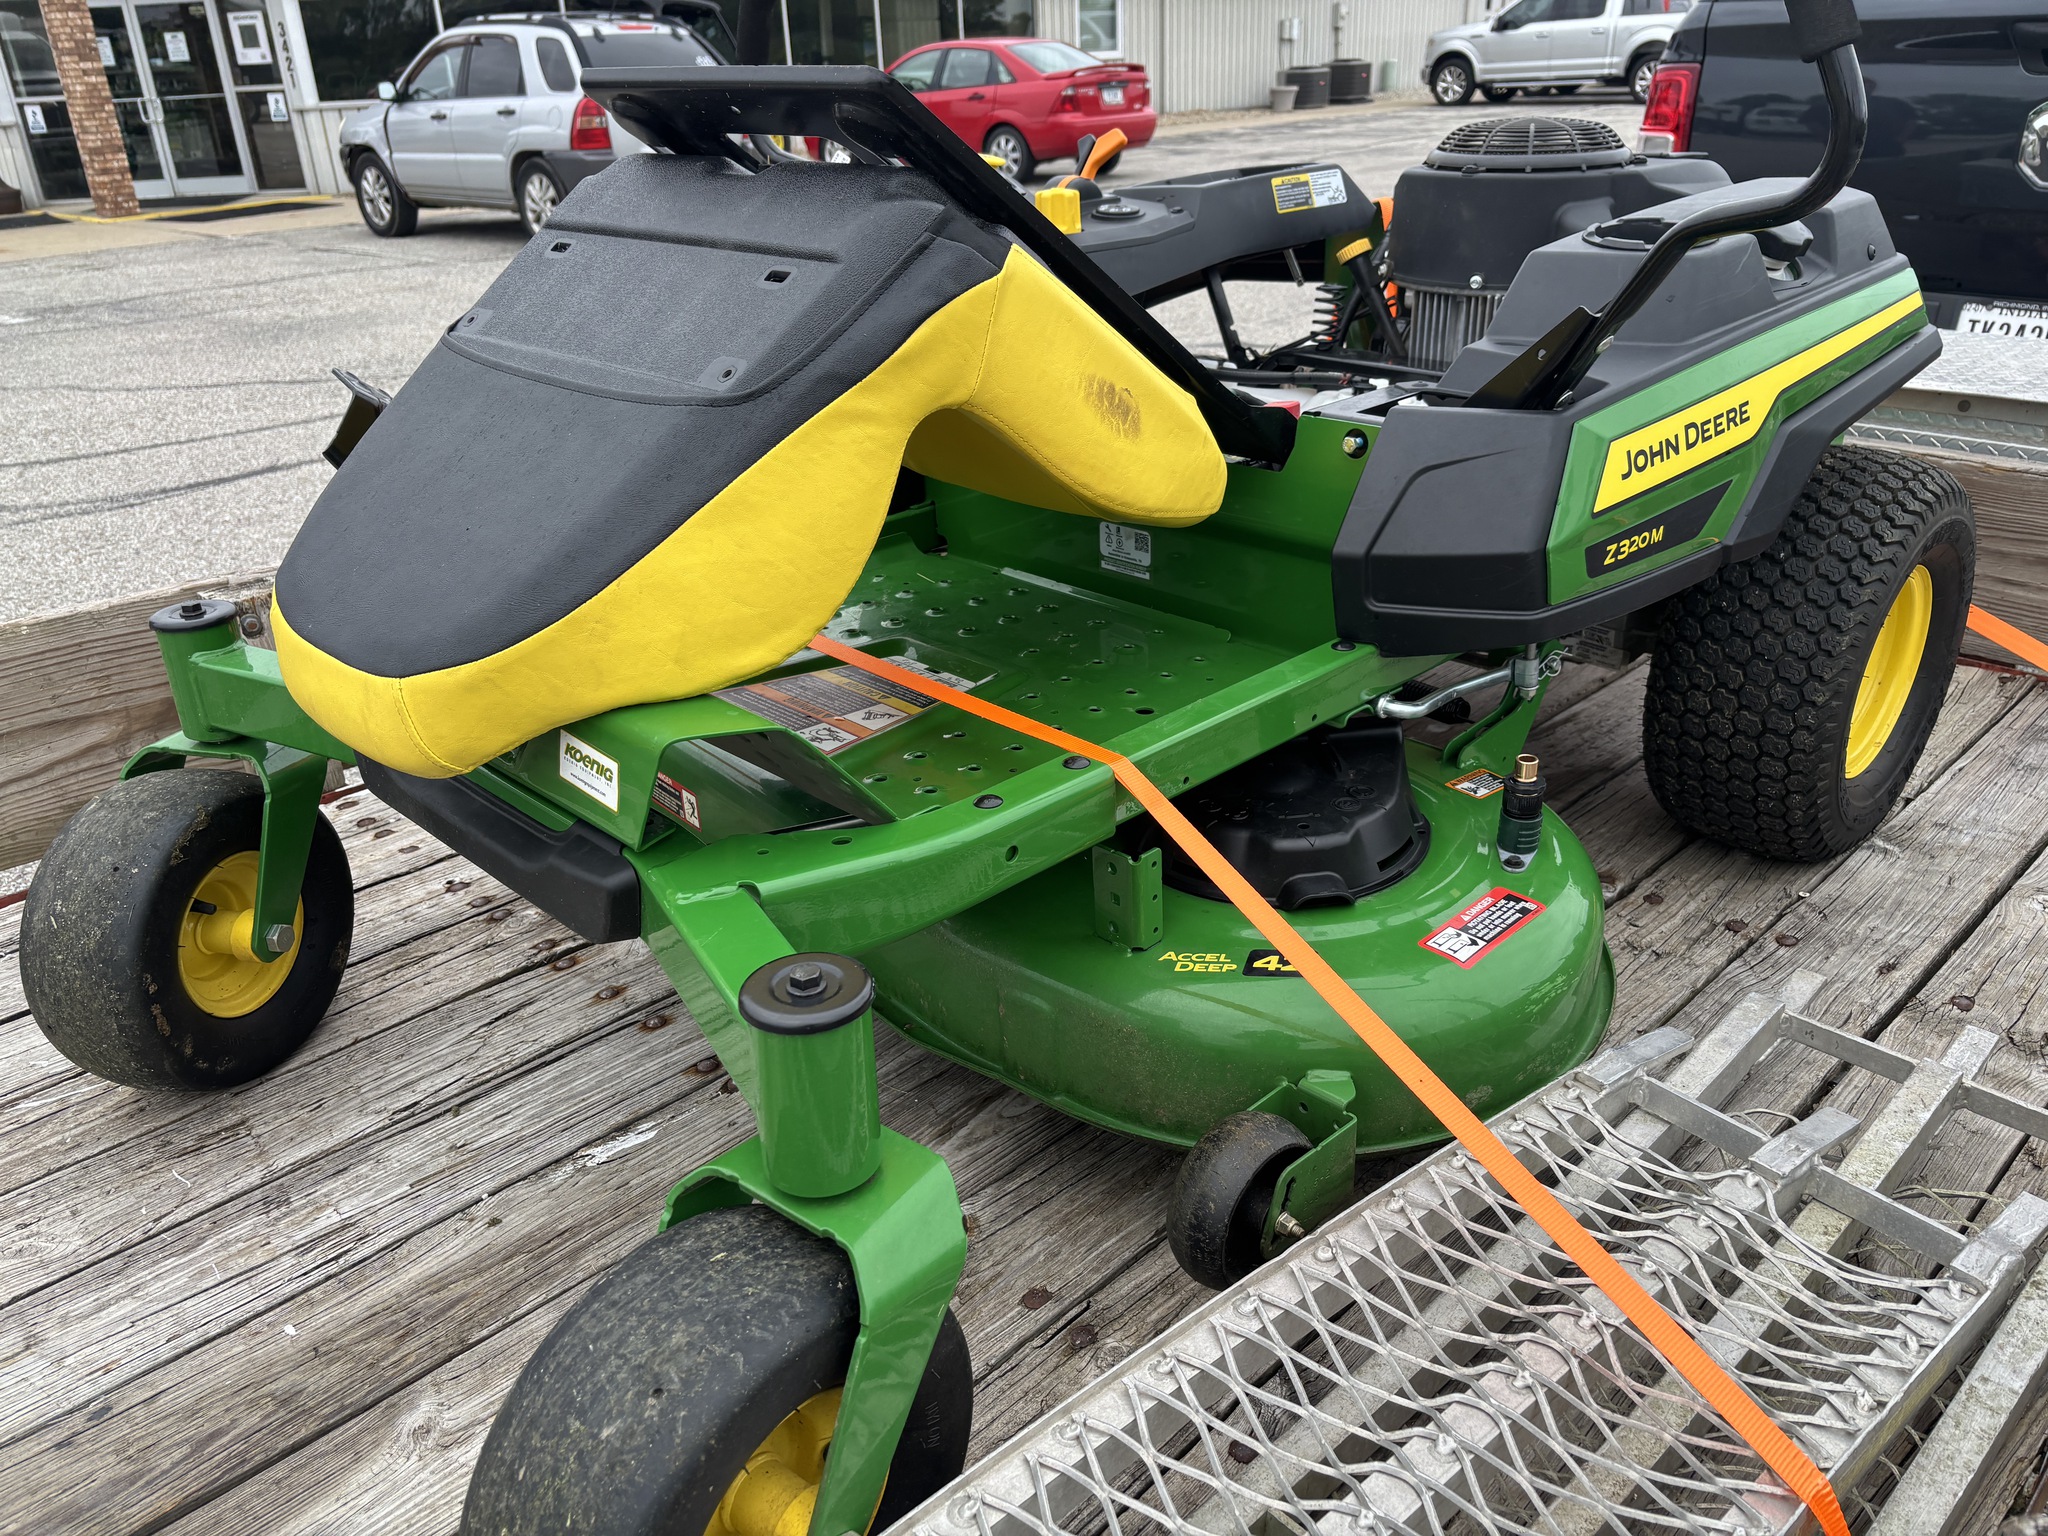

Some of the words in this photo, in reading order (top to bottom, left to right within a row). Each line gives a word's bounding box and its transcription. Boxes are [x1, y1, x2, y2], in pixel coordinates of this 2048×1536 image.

[277, 21, 296, 89] 3421
[1621, 433, 1680, 481] JOHN
[1684, 400, 1750, 451] DEERE
[1603, 525, 1665, 566] Z320M
[1466, 896, 1495, 916] DANGER
[1158, 951, 1232, 962] ACCEL
[1174, 961, 1238, 972] DEEP
